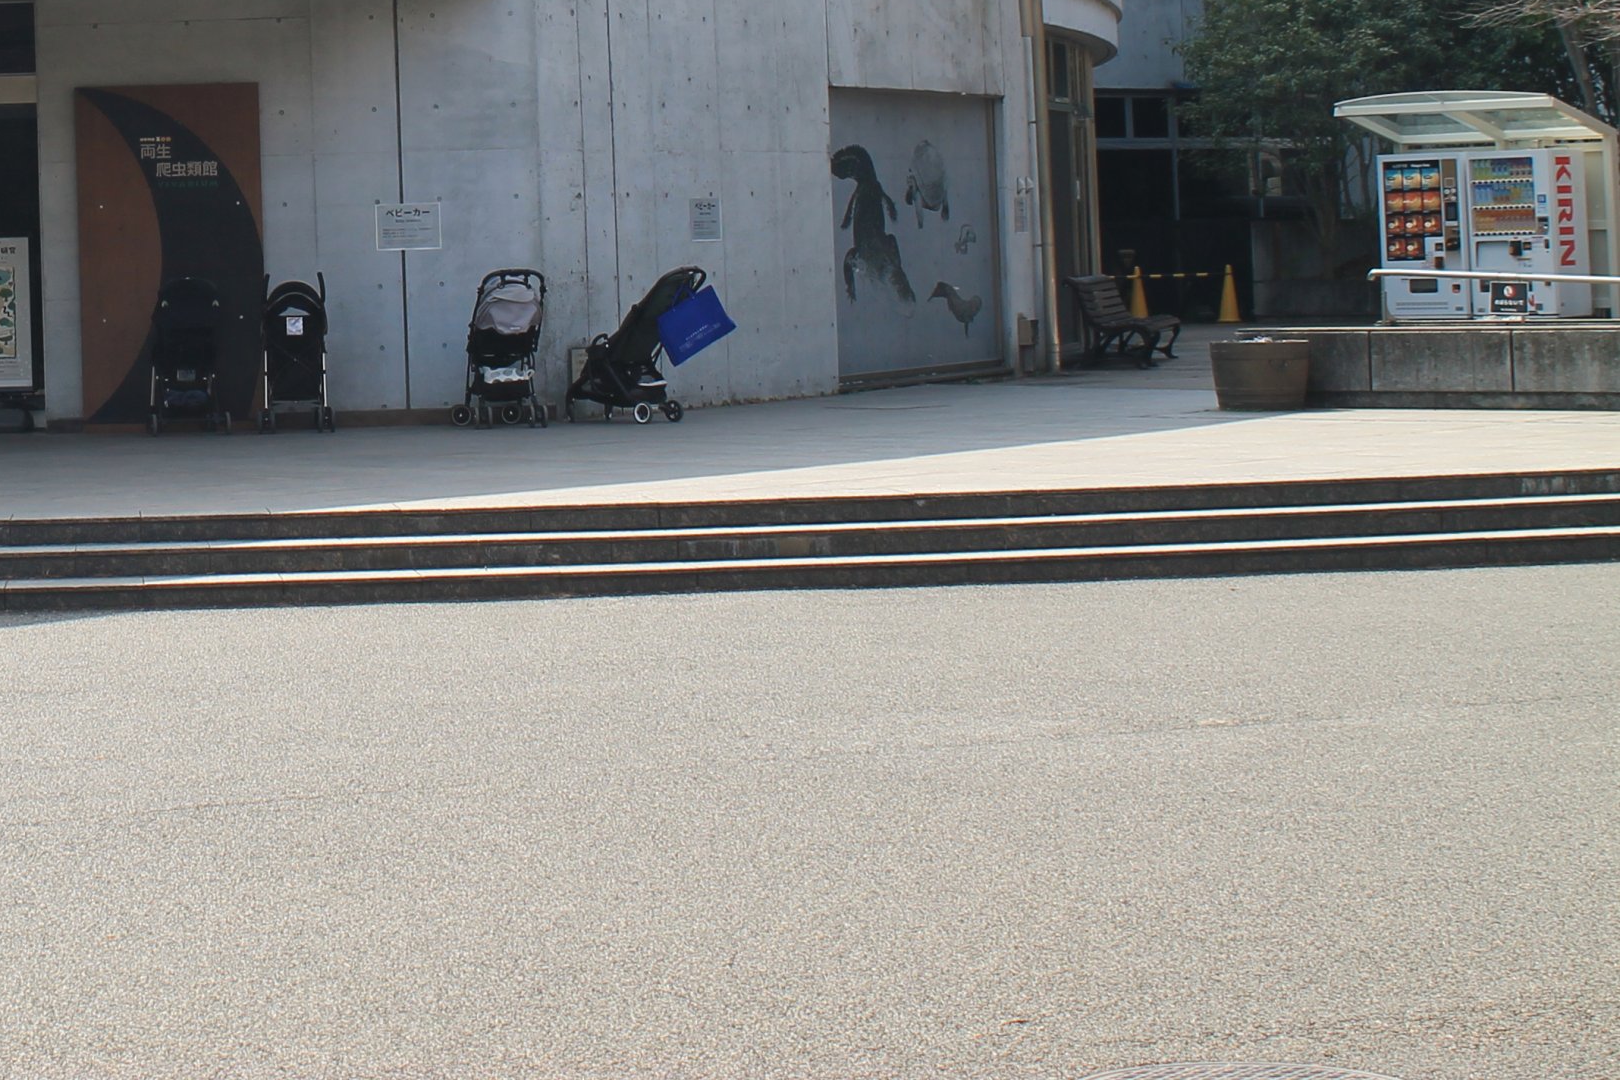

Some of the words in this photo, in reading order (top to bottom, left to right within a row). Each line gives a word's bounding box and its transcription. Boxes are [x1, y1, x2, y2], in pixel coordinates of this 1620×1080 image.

[140, 143, 171, 159] 両生
[156, 160, 218, 177] 爬虫類館
[385, 208, 430, 218] ベビーカー
[1555, 156, 1576, 266] KIRIN
